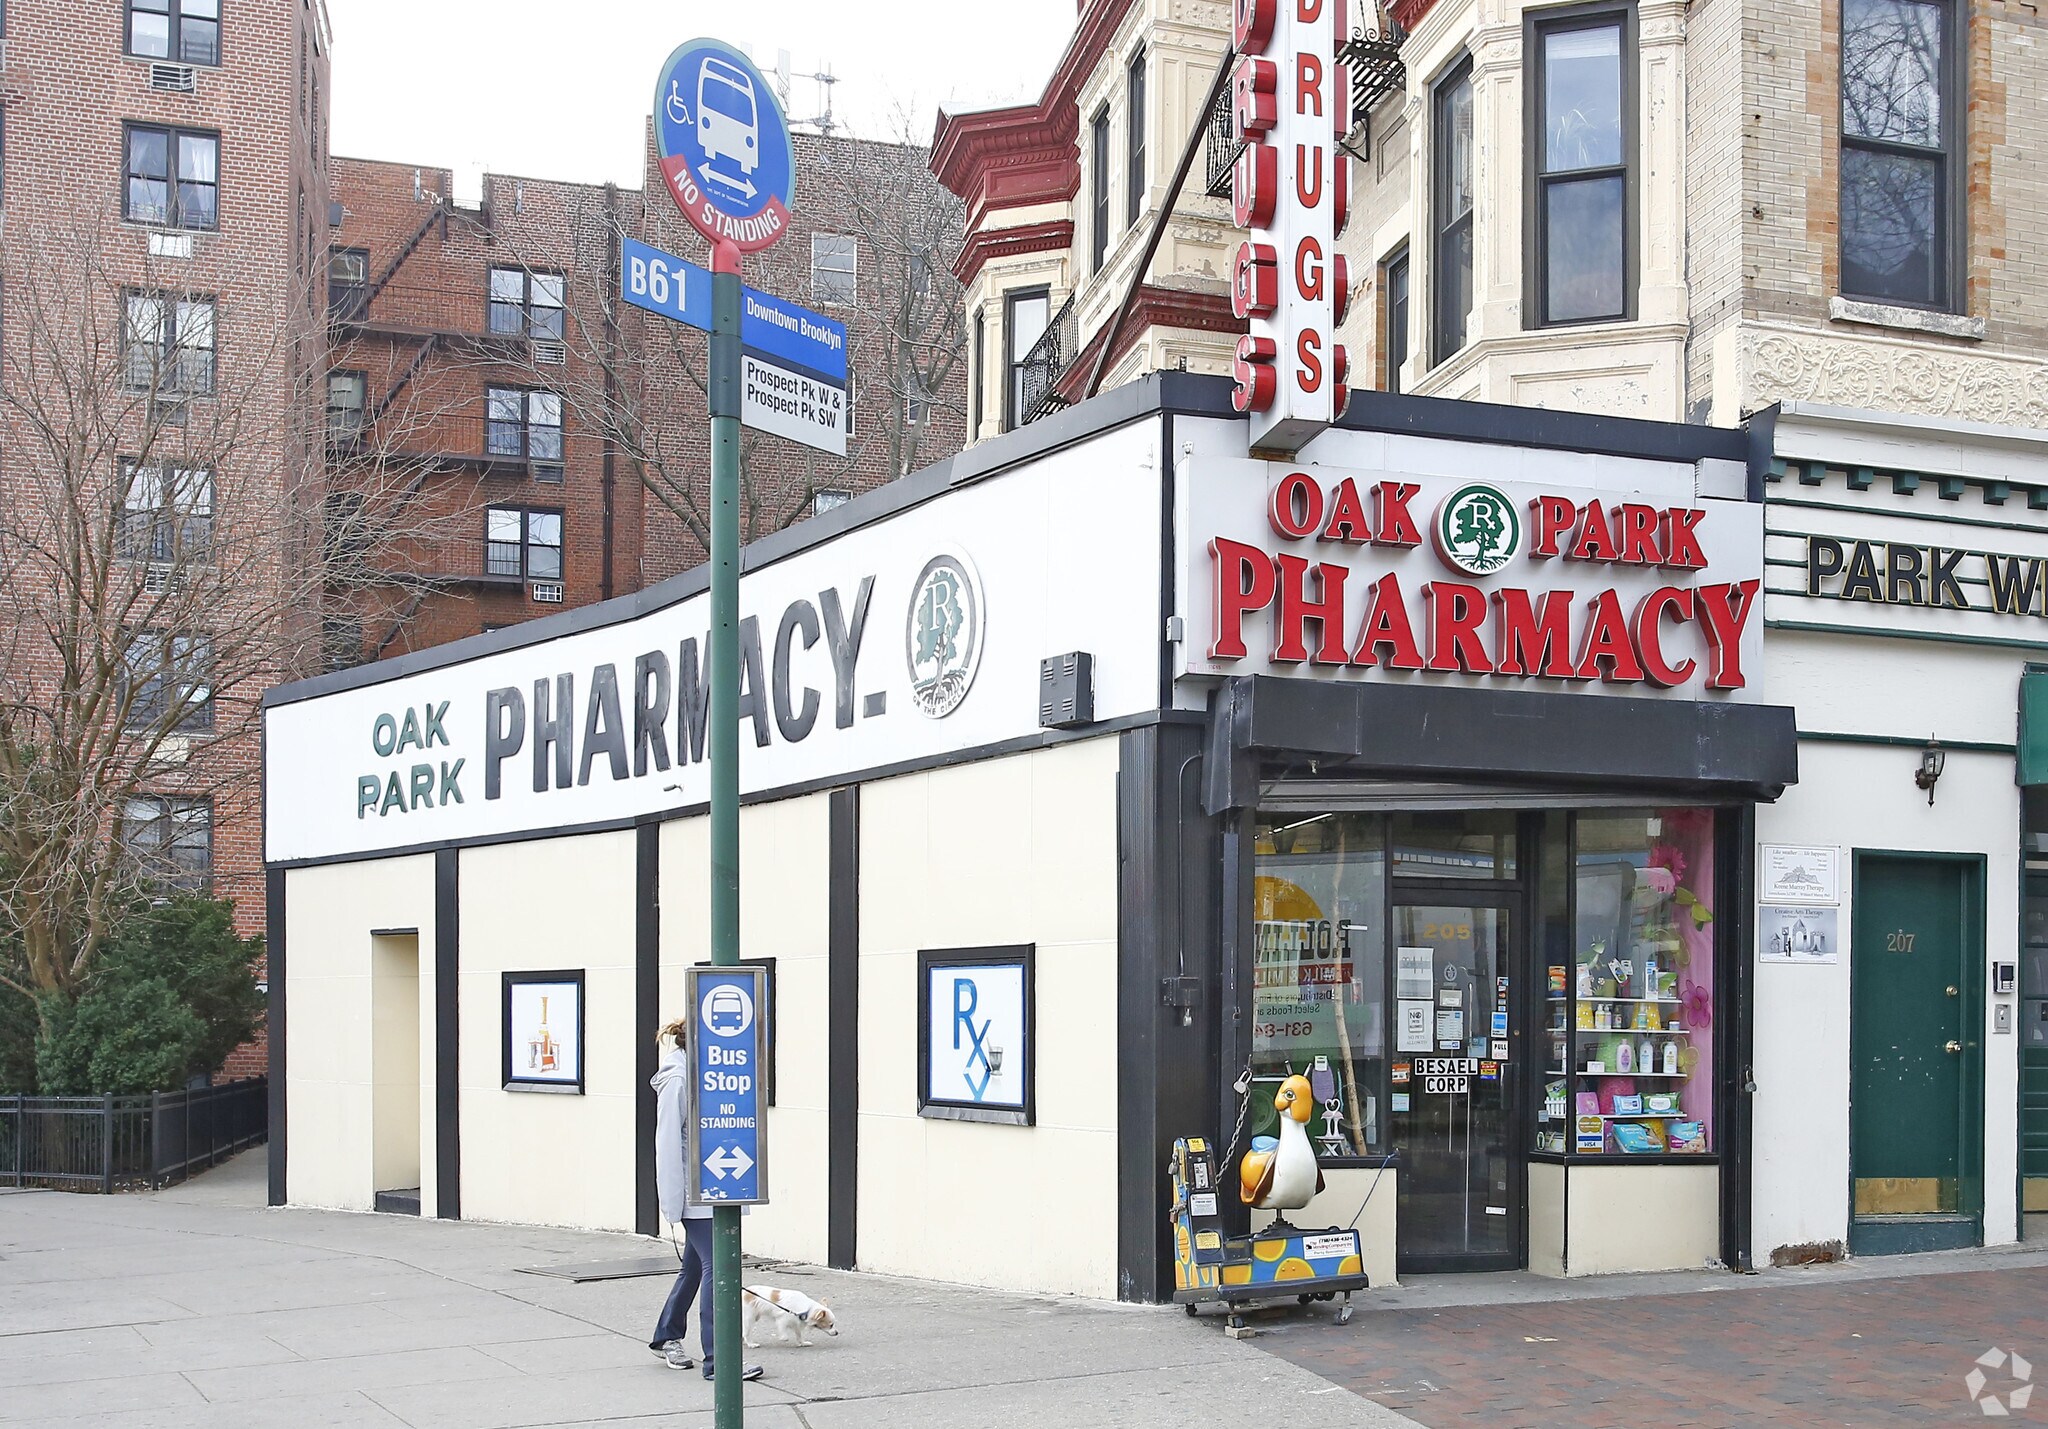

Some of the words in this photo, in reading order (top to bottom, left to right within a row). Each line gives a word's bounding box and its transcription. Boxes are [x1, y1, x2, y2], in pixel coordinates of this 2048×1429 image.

[673, 168, 699, 205] NO
[702, 202, 781, 242] STANDING
[630, 256, 686, 313] B61
[747, 296, 799, 334] Downtown
[800, 317, 842, 350] Brooklyn
[747, 361, 799, 392] Prospect
[801, 380, 816, 399] Pk
[818, 389, 834, 406] W
[832, 392, 841, 410] &
[747, 384, 799, 417] Prospect
[801, 402, 816, 422] Pk
[818, 410, 837, 429] SW
[1267, 471, 1424, 549] OAK
[1528, 494, 1708, 571] PARK
[1807, 535, 1970, 609] PARK
[1983, 553, 2048, 618] W
[1206, 535, 1761, 690] PHARMACY
[923, 705, 936, 716] THE
[372, 699, 452, 758] OAK
[357, 757, 467, 820] PARK
[1423, 922, 1471, 940] 205
[1886, 933, 1916, 953] 207
[708, 1045, 748, 1066] Bus
[1494, 1043, 1507, 1051] PULL
[703, 1070, 751, 1096] Stop
[1416, 1059, 1477, 1074] BESAEL
[1427, 1078, 1466, 1092] CORP
[700, 1117, 756, 1129] STANDING
[719, 1103, 736, 1115] NO
